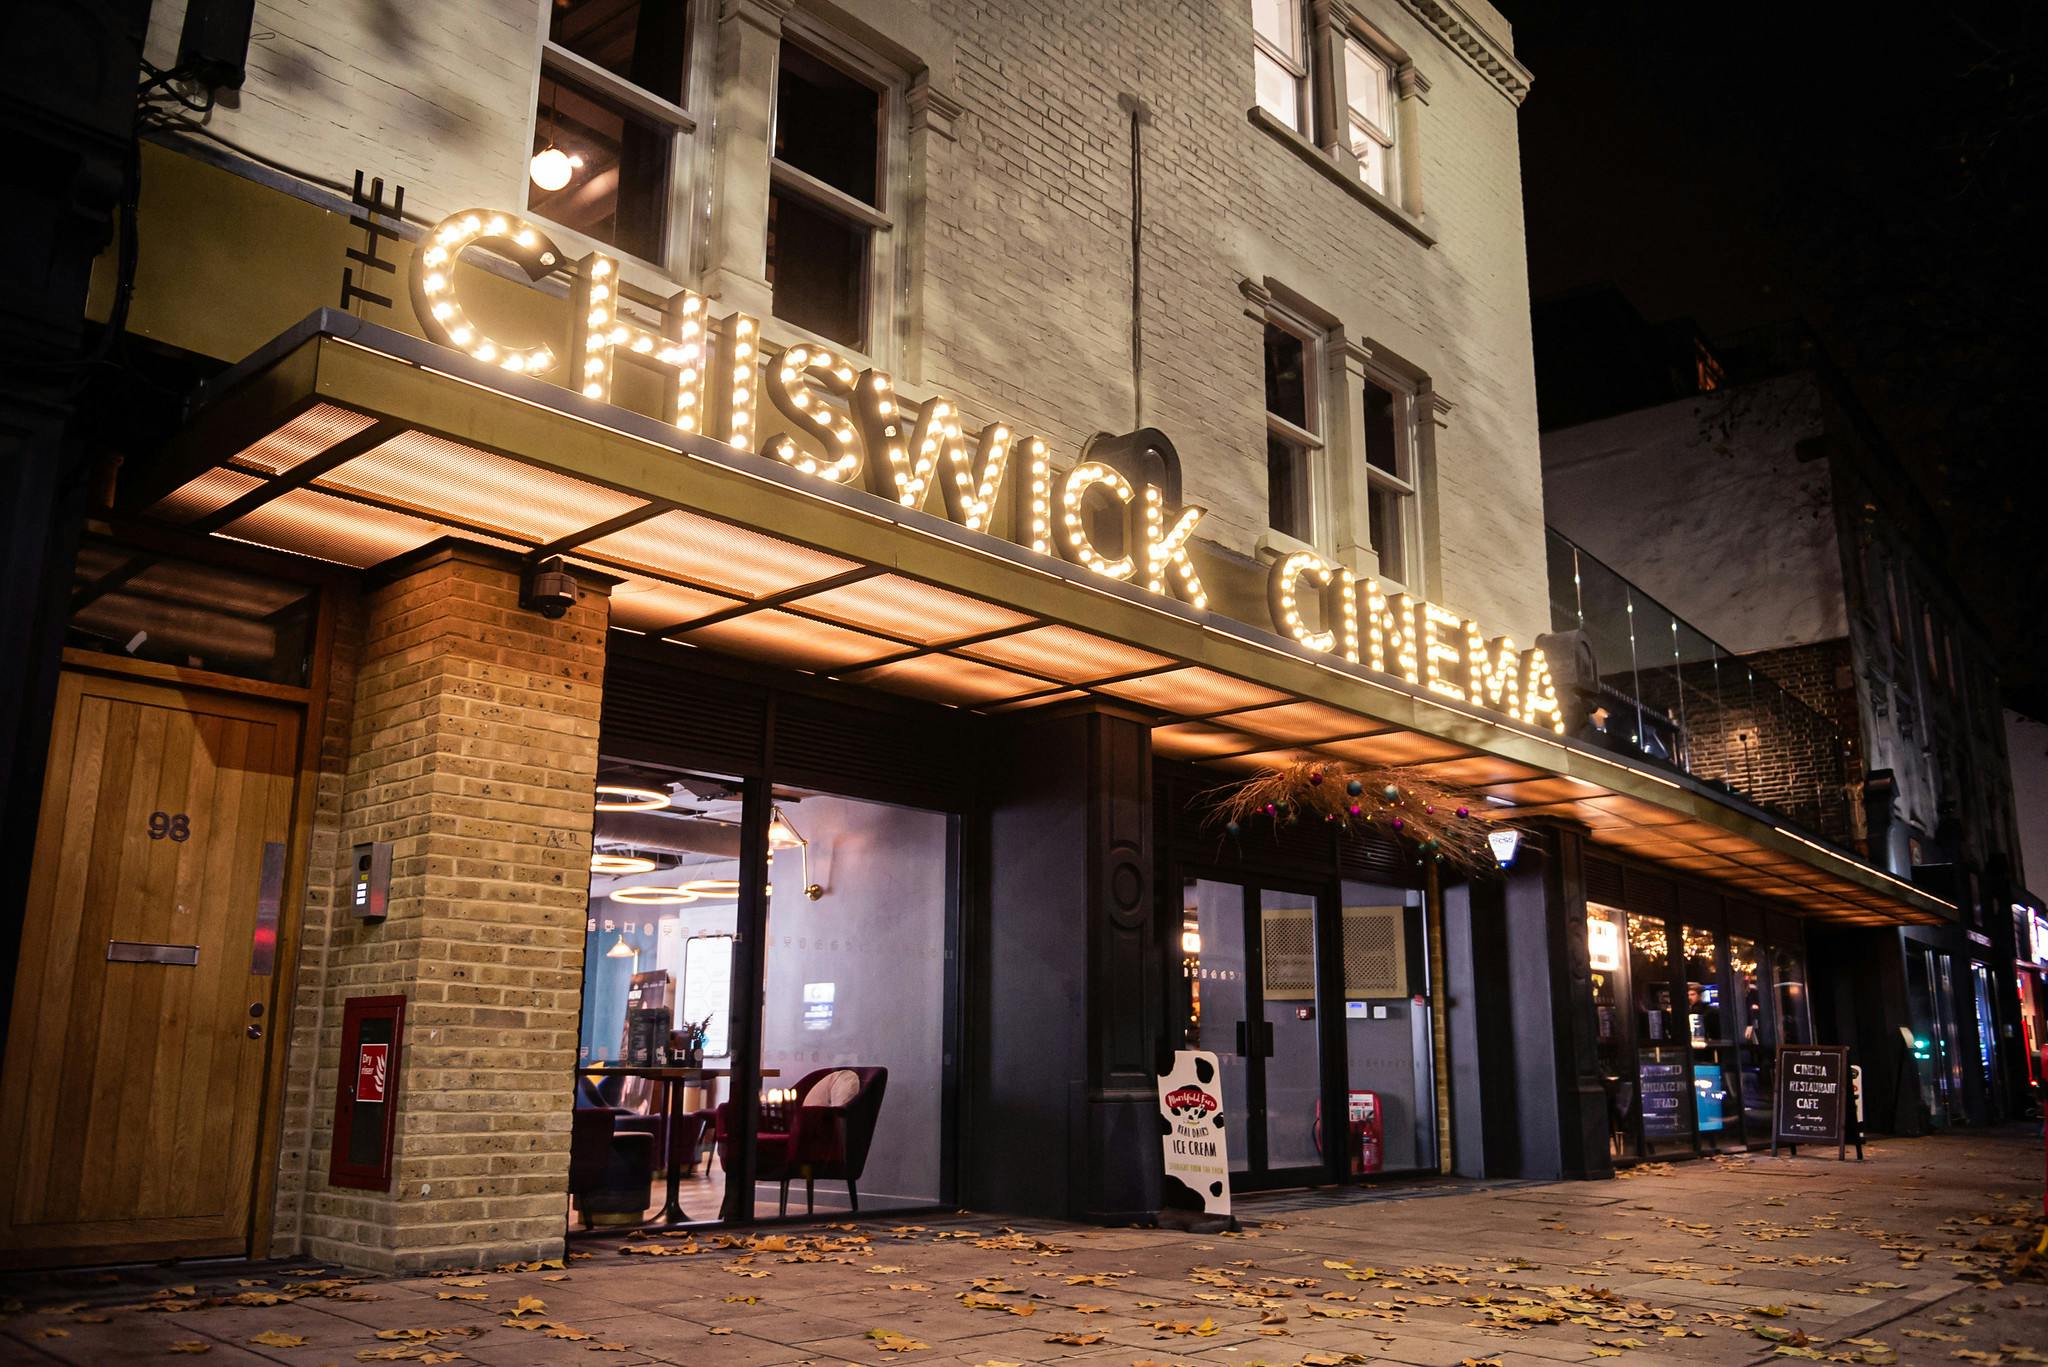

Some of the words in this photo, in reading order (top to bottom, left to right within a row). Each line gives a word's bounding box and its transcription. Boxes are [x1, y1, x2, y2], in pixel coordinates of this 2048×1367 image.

[339, 169, 405, 310] THE
[408, 207, 1209, 609] CHISWICK
[1267, 550, 1565, 735] CINEMA
[148, 811, 191, 843] 98
[362, 1054, 373, 1066] Dry
[361, 1065, 375, 1075] riser
[1793, 1064, 1827, 1077] CINEMA
[1789, 1080, 1837, 1094] RESTAURANT
[1796, 1098, 1819, 1109] CAFE
[1177, 1124, 1190, 1137] REAL
[1192, 1127, 1209, 1138] DAIRY
[1173, 1140, 1186, 1154] ICE
[1188, 1141, 1217, 1157] CREAM
